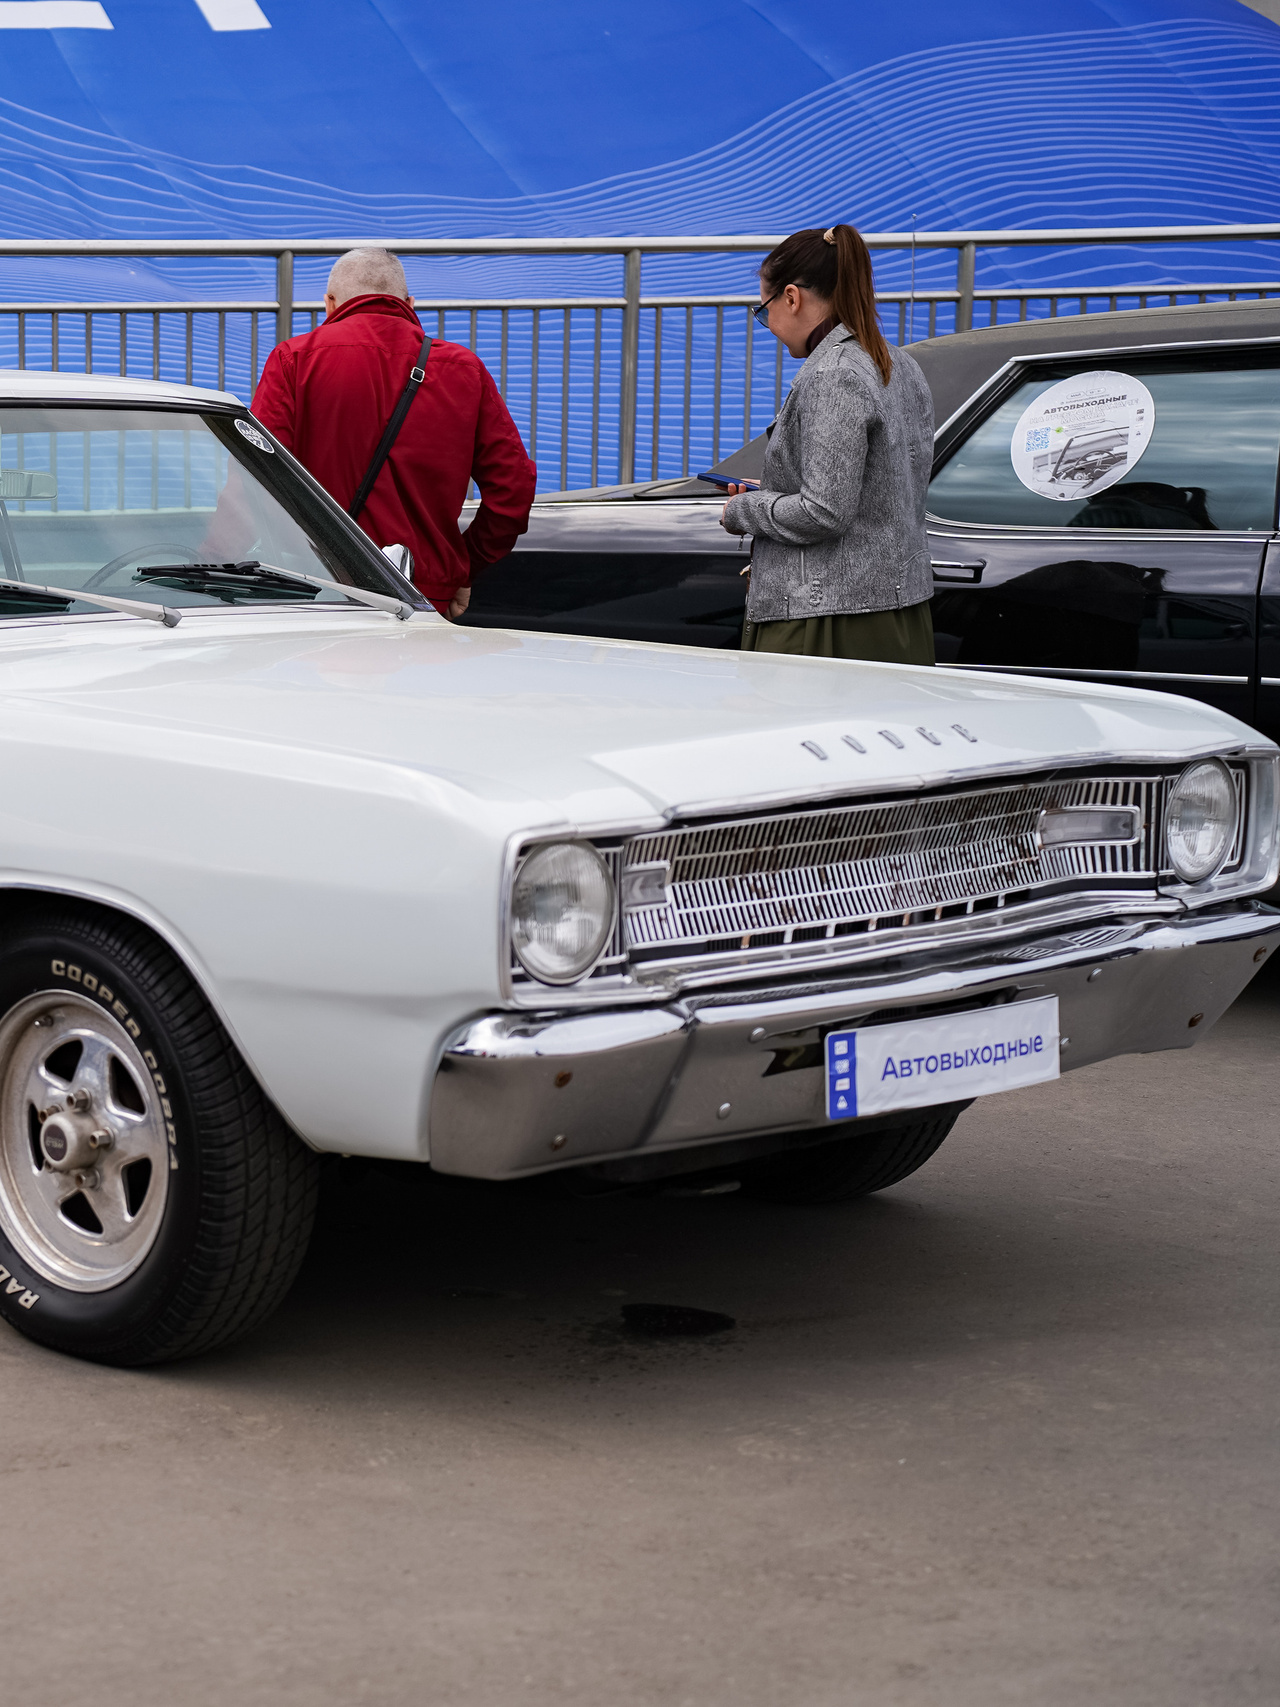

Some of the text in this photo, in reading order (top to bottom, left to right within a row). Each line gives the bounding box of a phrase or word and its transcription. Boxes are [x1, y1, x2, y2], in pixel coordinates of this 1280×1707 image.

[1043, 394, 1128, 415] АВТОВЫХОДНЫЕ
[51, 959, 179, 1170] COOPER COBRA
[881, 1035, 1043, 1081] Автовыходные
